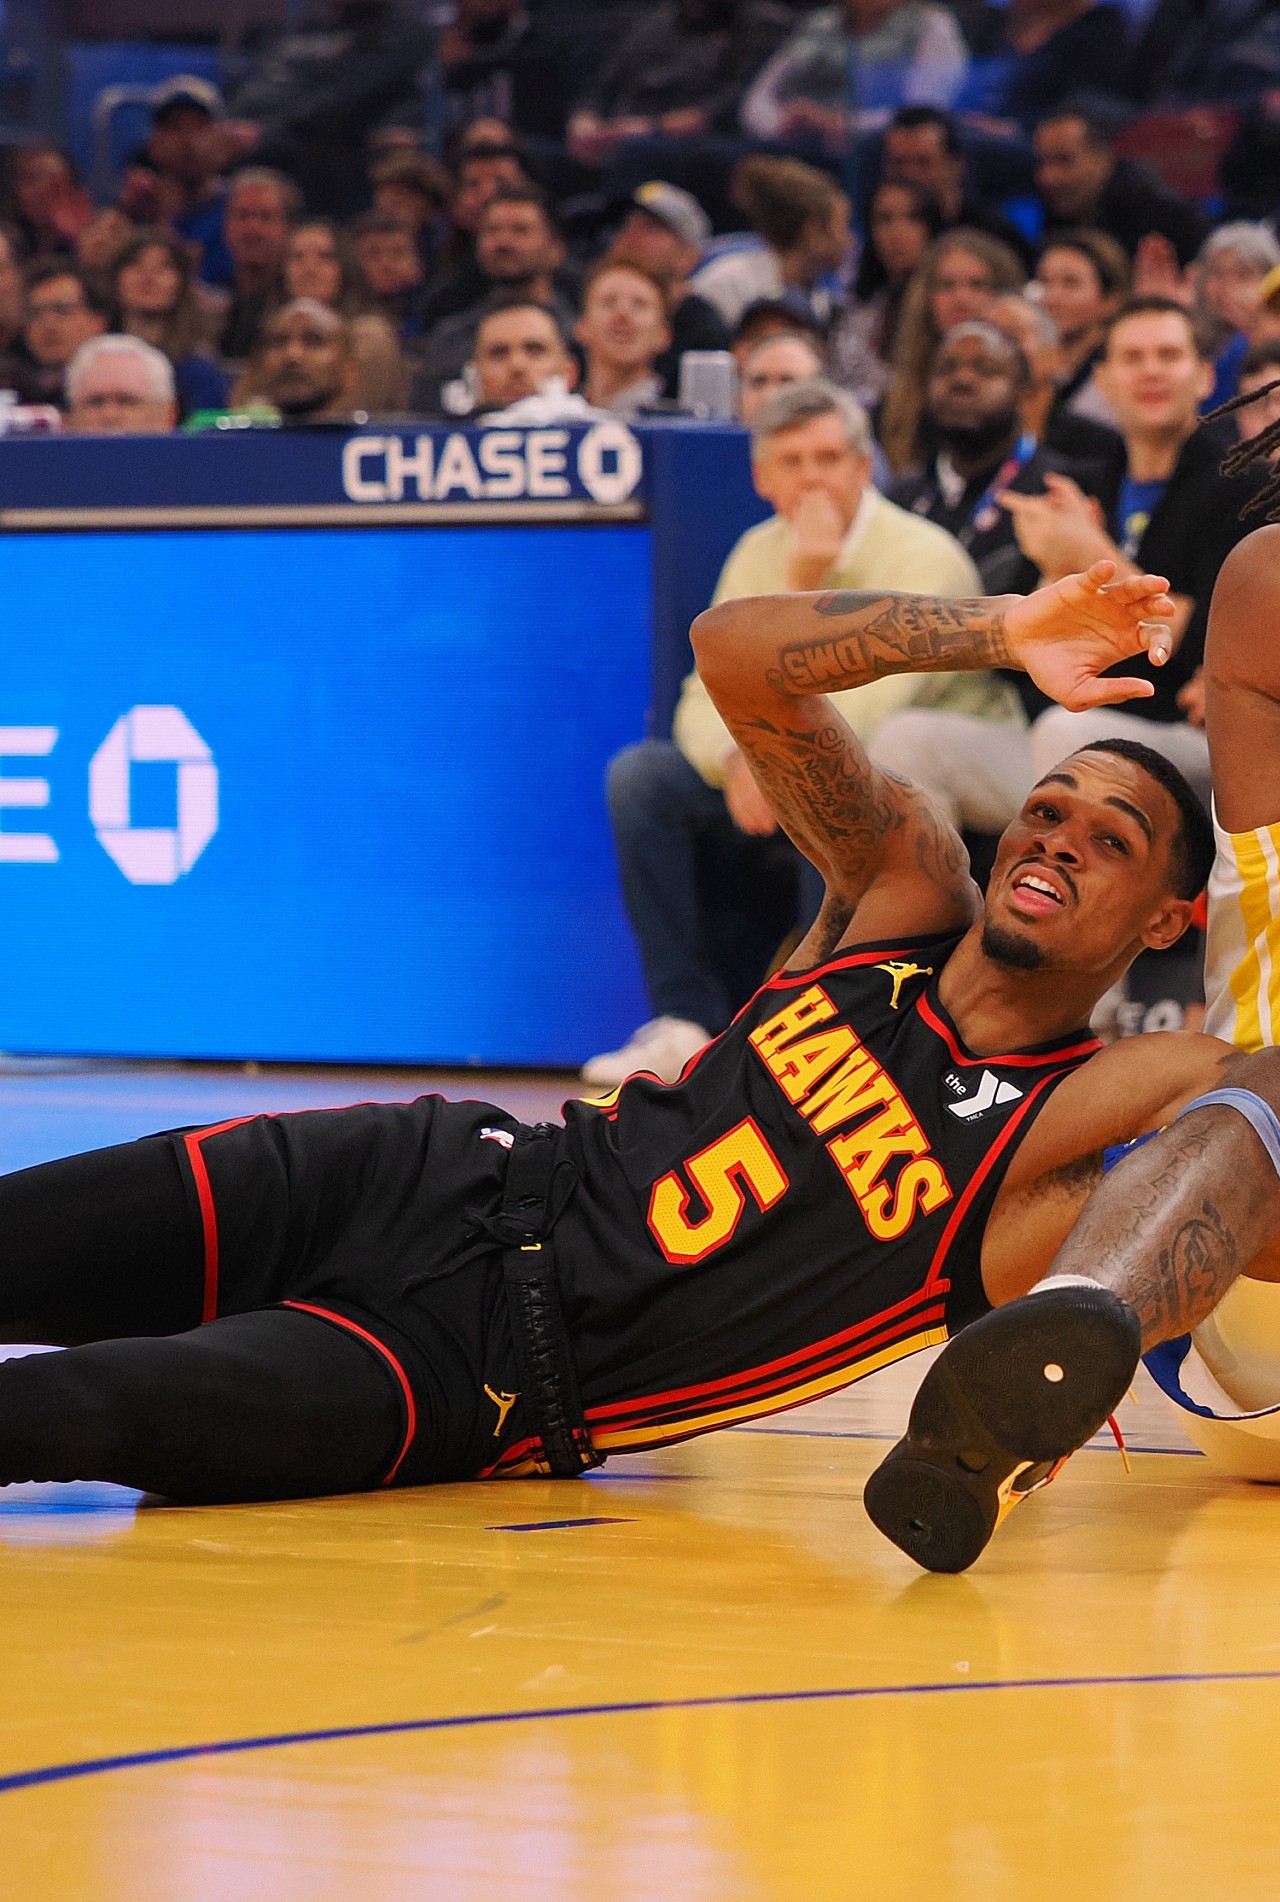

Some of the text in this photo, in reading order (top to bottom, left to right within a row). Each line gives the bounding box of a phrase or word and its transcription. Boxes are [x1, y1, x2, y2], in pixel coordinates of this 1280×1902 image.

[342, 430, 571, 502] CHASE
[747, 983, 954, 1241] HAWKS
[945, 1073, 967, 1096] the
[965, 1112, 984, 1122] YMCA
[646, 1115, 791, 1265] 5
